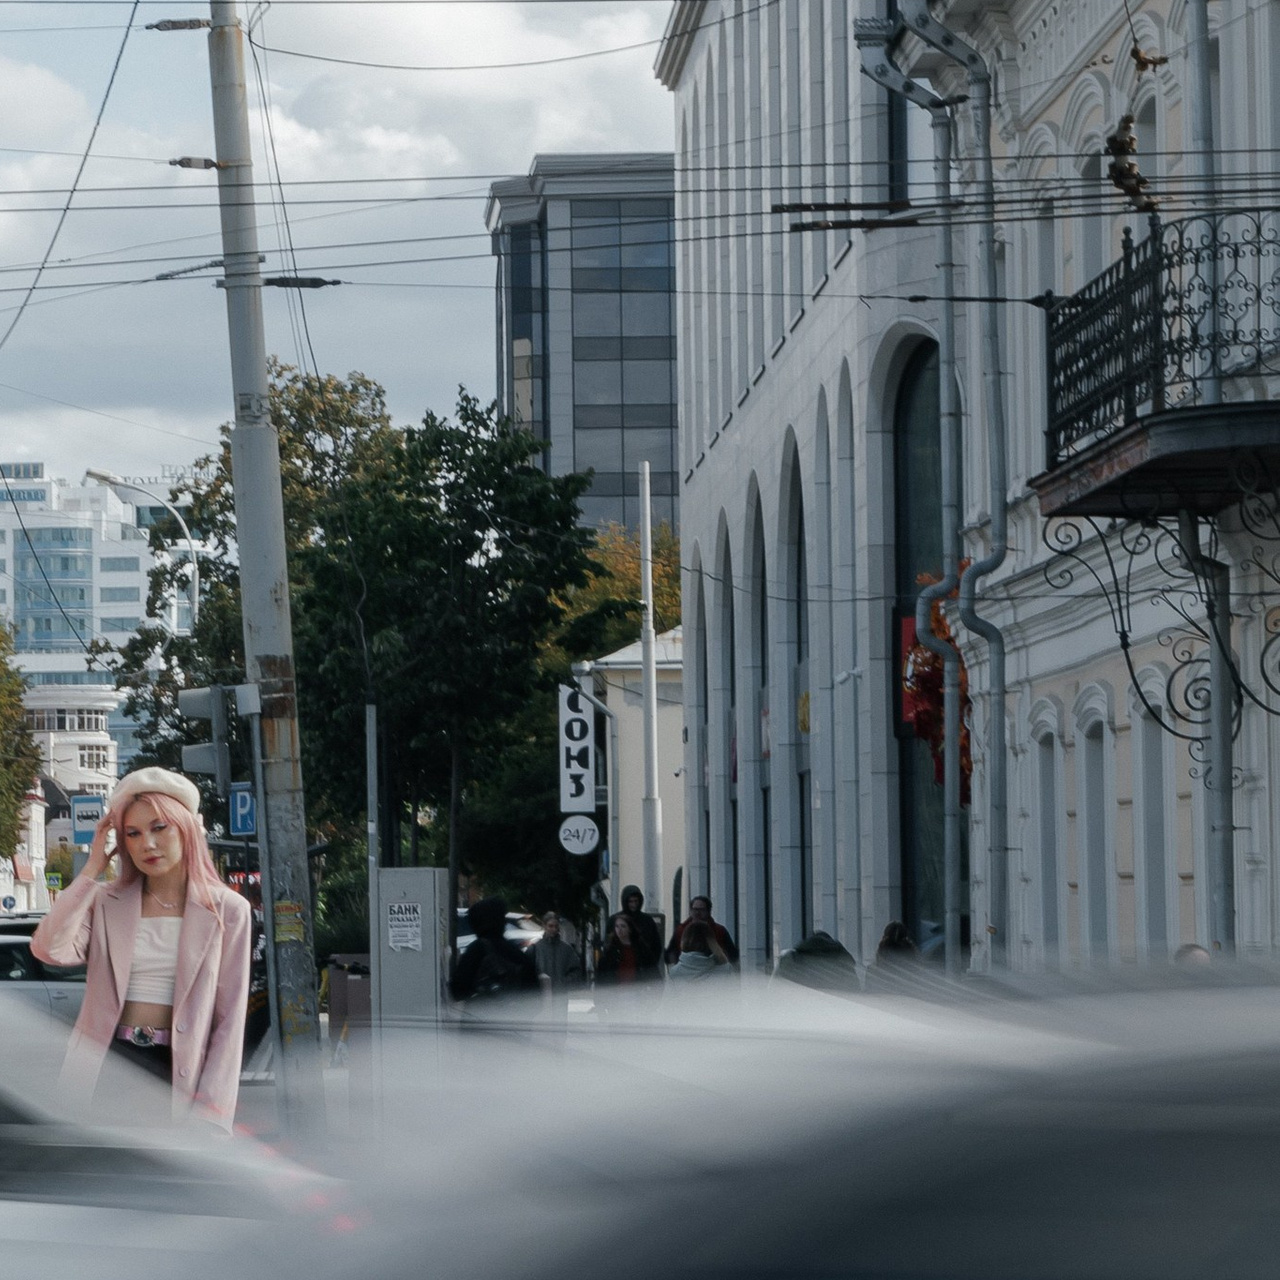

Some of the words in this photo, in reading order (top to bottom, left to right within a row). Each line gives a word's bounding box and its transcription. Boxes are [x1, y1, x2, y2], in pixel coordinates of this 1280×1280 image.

[236, 792, 251, 829] P
[563, 828, 596, 844] 24/7
[389, 904, 419, 915] БАНК
